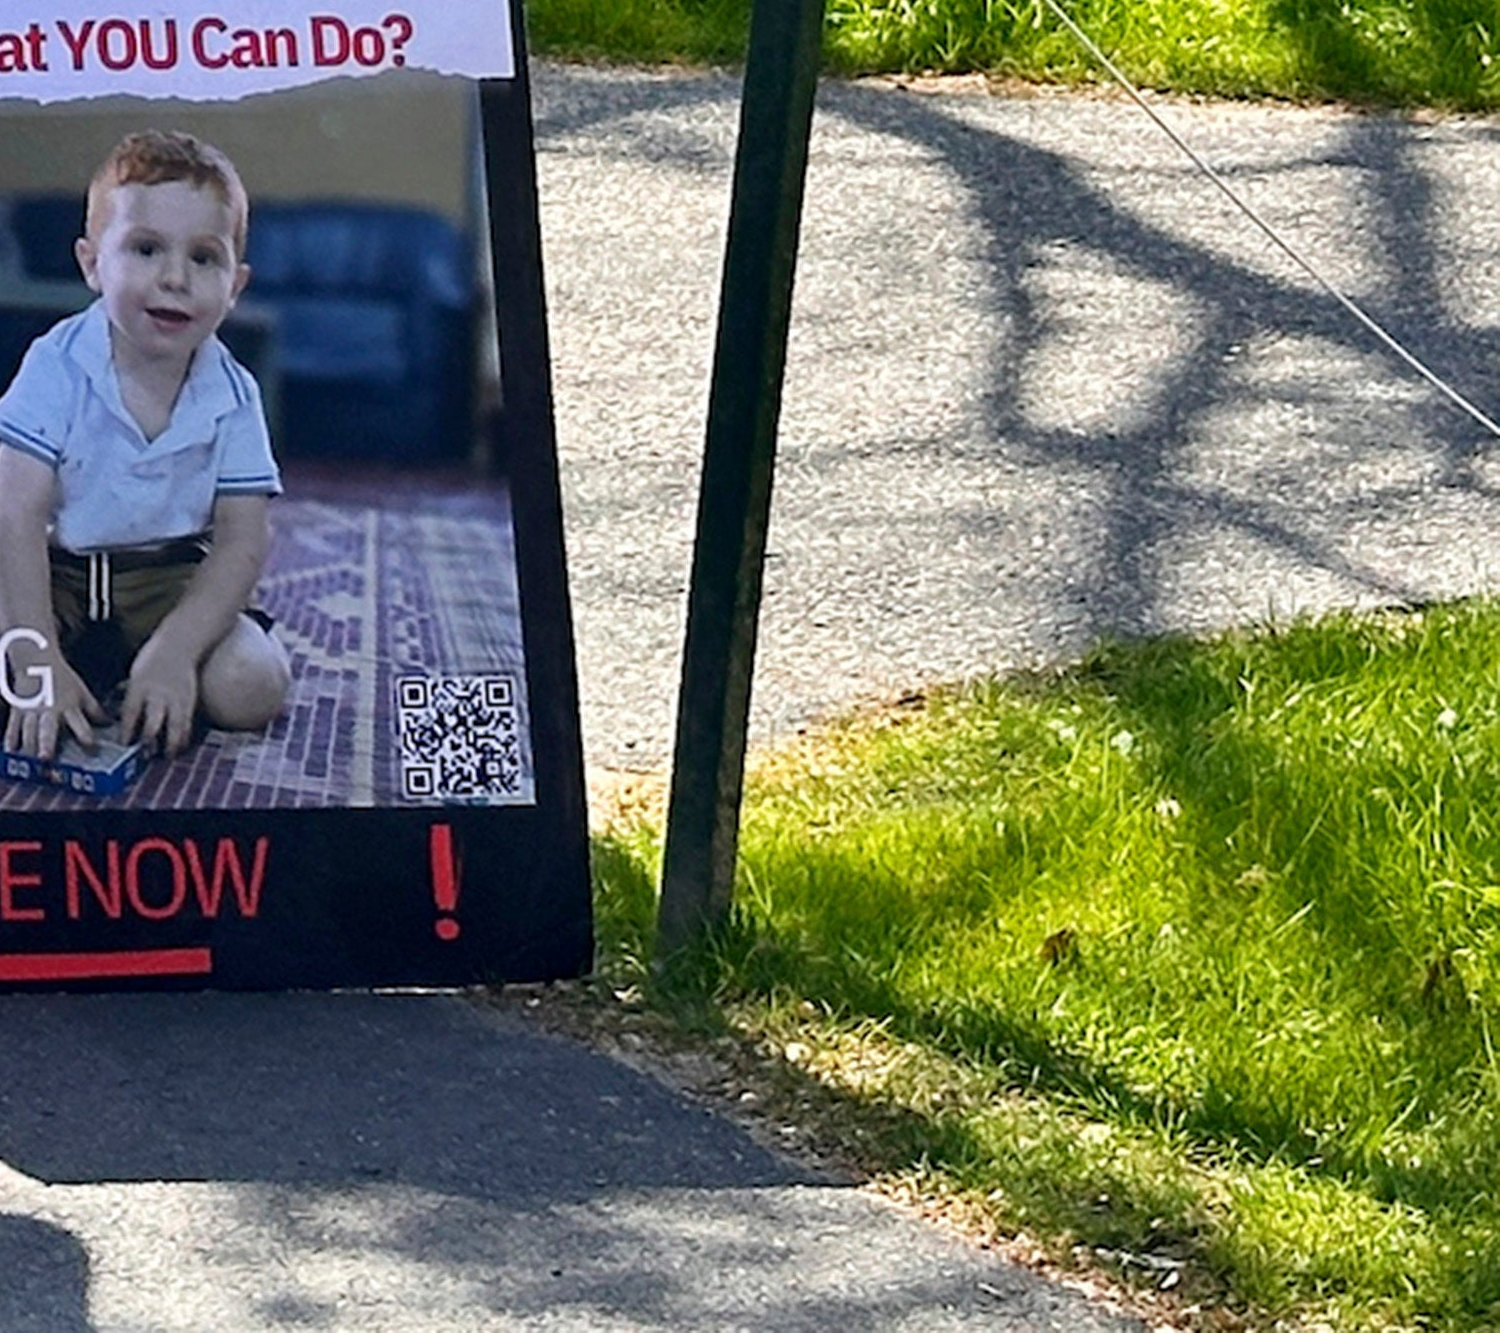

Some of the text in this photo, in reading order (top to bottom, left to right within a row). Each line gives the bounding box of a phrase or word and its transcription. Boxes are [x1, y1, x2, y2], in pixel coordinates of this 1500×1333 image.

[56, 17, 179, 72] YOU
[191, 16, 299, 69] Can
[309, 13, 414, 68] Do?
[64, 836, 270, 919] NOW
